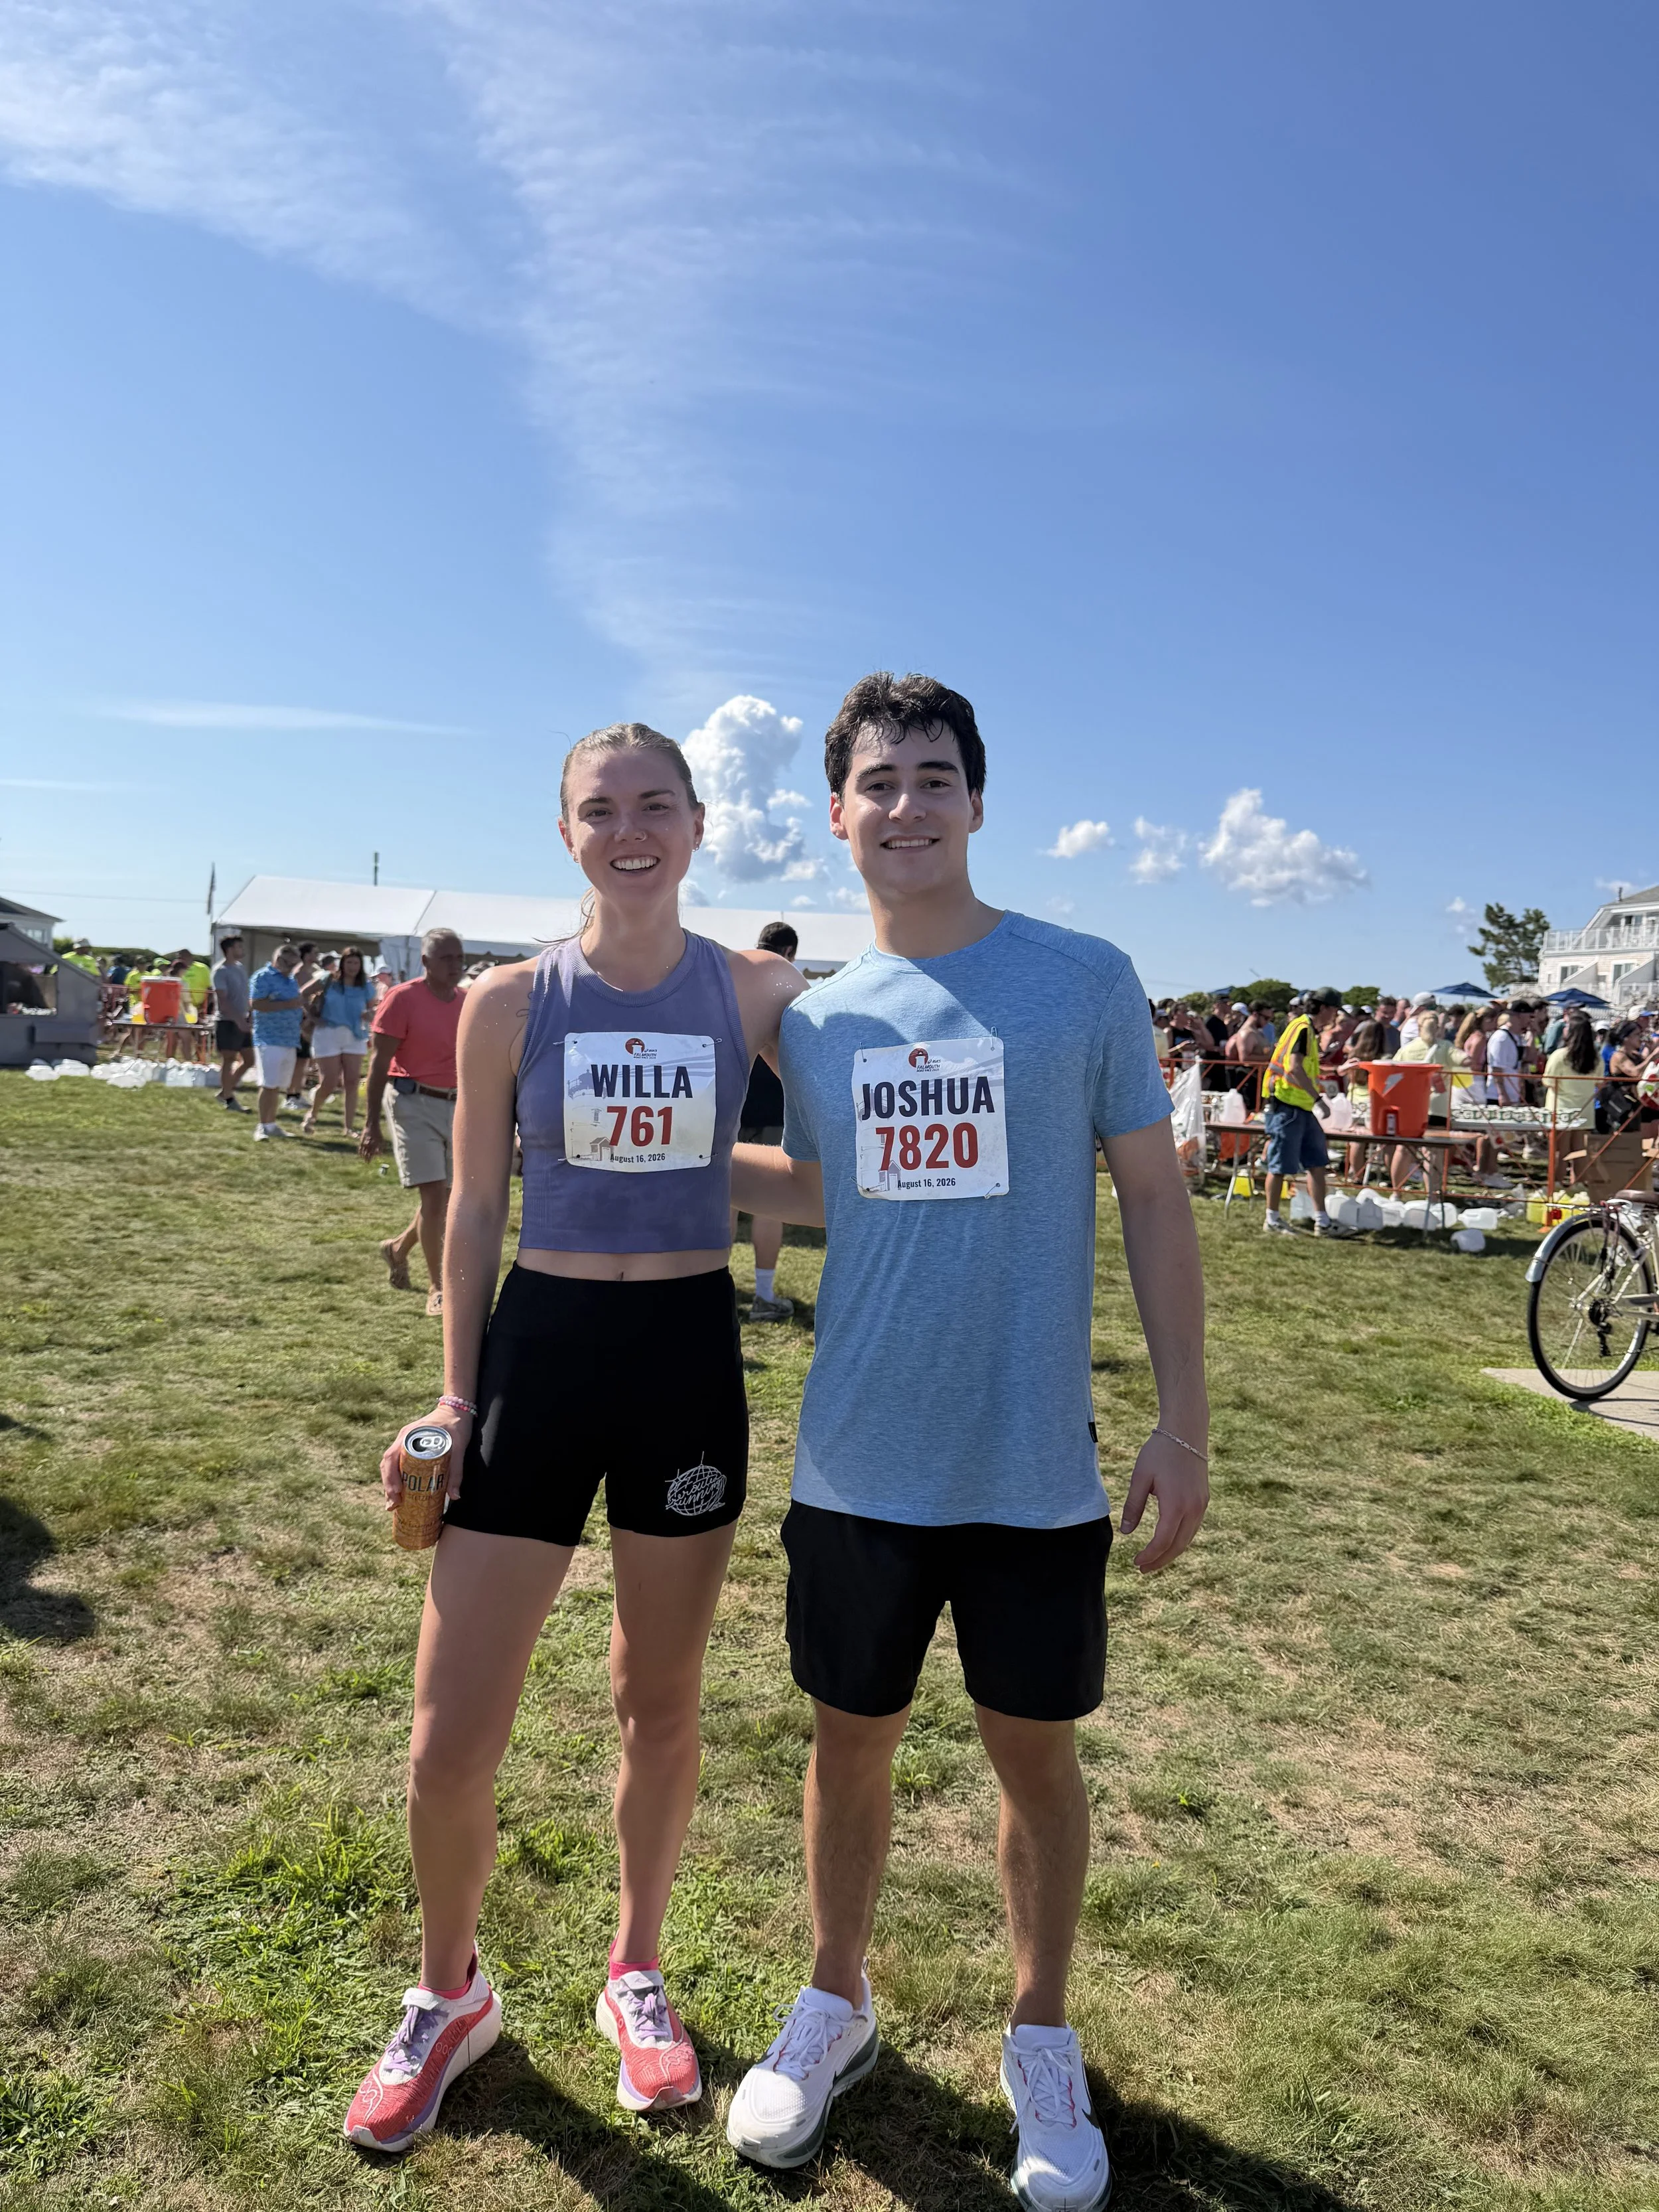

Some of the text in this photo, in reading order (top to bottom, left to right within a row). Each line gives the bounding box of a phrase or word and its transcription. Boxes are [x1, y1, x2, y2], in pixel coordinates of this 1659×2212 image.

[591, 1064, 693, 1098] WILLA
[861, 1076, 995, 1121] JOSHUA
[607, 1106, 673, 1147] 761
[610, 1153, 634, 1163] August
[648, 1153, 666, 1161] 2026
[875, 1122, 979, 1171] 7820
[897, 1177, 956, 1189] August 16, 2026
[401, 1471, 444, 1492] POLAR
